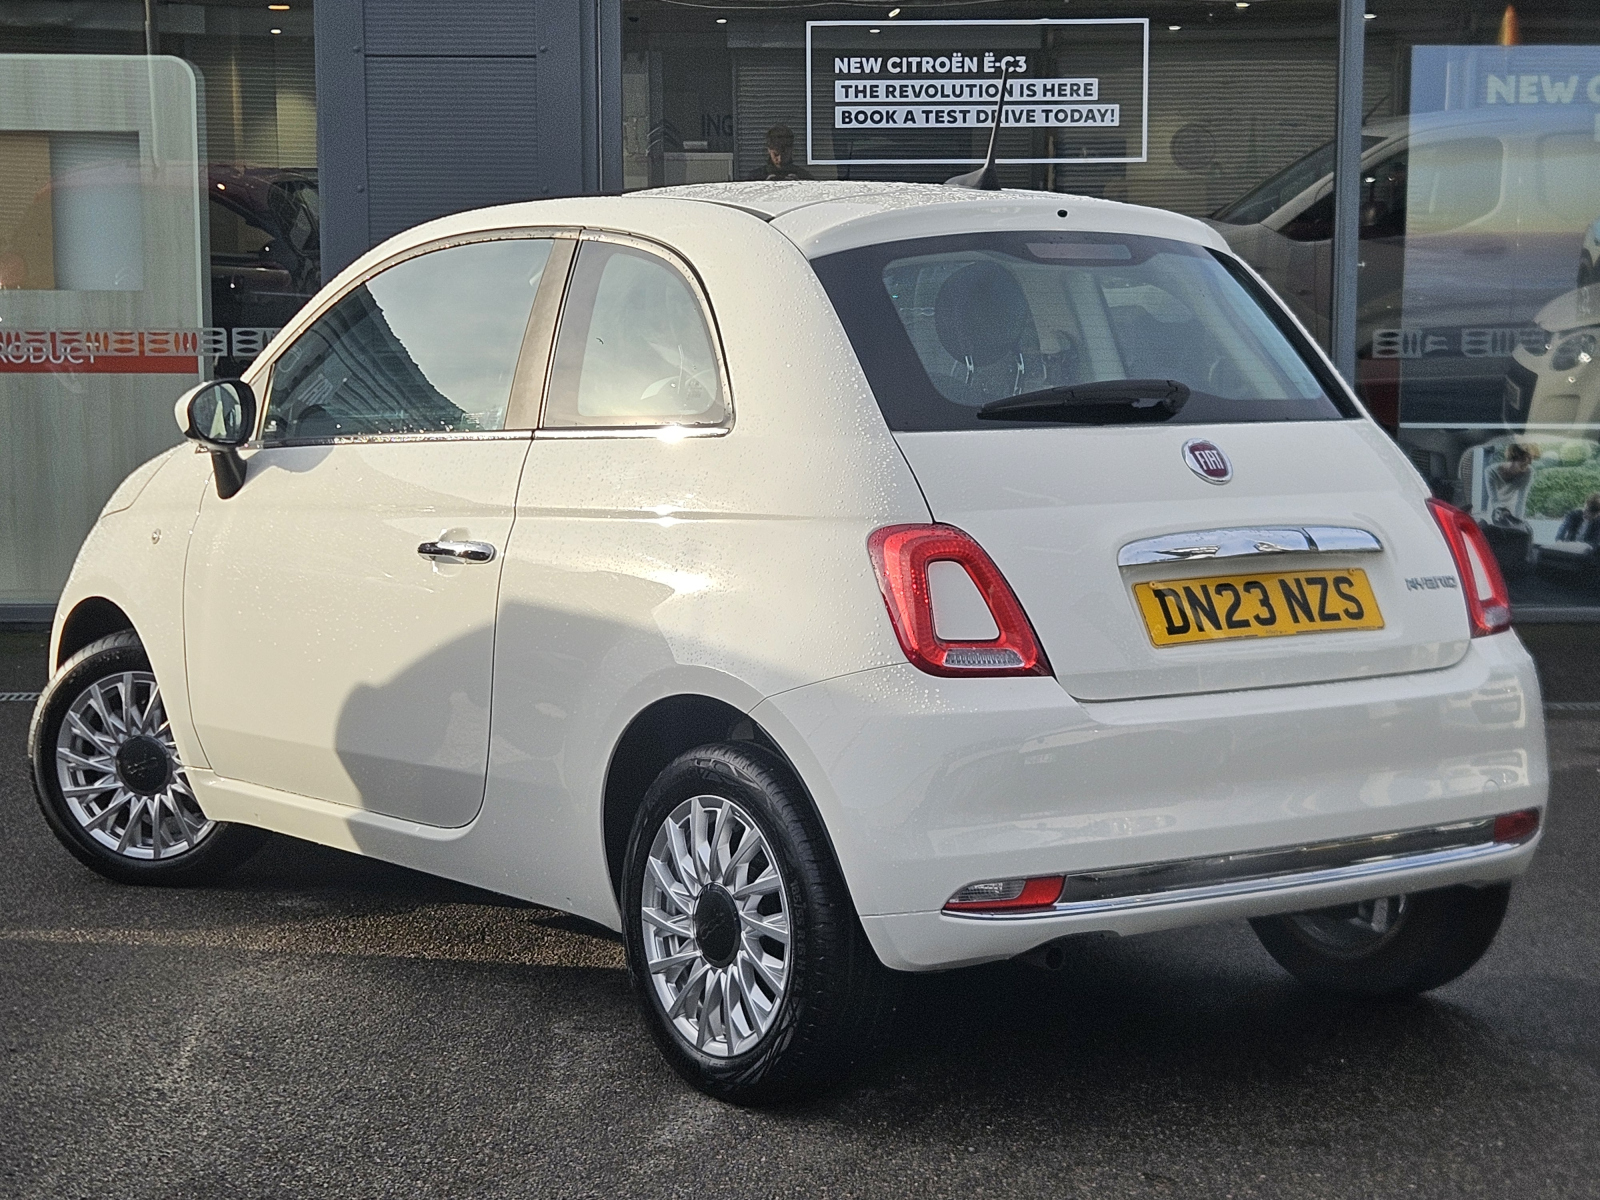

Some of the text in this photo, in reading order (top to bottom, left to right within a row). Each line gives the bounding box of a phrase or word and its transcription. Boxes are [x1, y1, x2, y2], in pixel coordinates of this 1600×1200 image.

[834, 57, 883, 74] NEW
[887, 52, 978, 74] CITROËN
[841, 82, 1094, 100] THE REVOLUTION IS HERE
[1486, 74, 1579, 104] NEW
[841, 110, 899, 125] BOOK
[902, 110, 918, 125] A
[922, 109, 971, 125] TEST
[1041, 108, 1116, 124] TODAY!
[1193, 450, 1225, 470] FIAT
[1404, 575, 1458, 591] HYBRID
[1152, 575, 1365, 636] DN23 NZS
